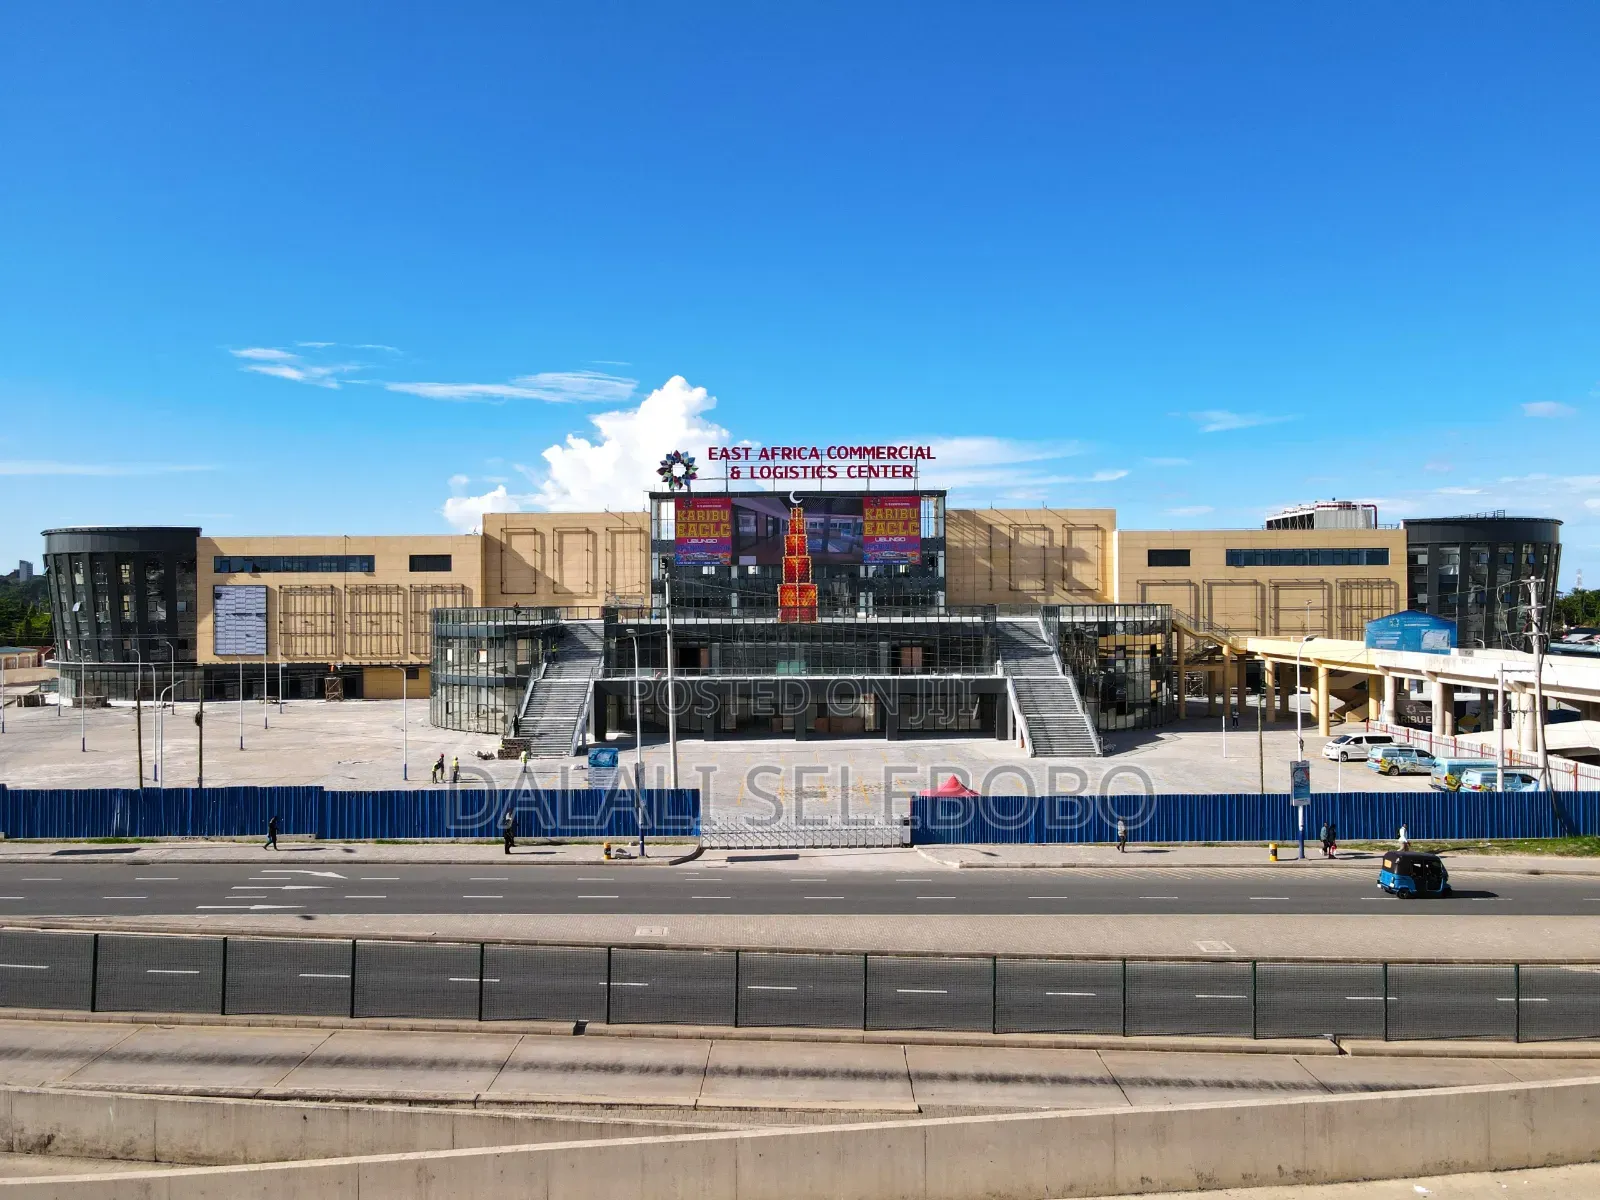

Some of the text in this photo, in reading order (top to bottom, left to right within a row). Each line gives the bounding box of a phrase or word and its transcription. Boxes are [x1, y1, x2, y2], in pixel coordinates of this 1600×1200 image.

[707, 446, 937, 460] EAST AFRICA COMMERCIAL
[729, 464, 914, 479] & LOGISTICS CENTER
[677, 510, 730, 522] KARIBU
[864, 508, 919, 520] KARIBU
[676, 523, 731, 537] EACLC
[864, 521, 920, 536] EACLC
[1395, 715, 1424, 724] ARIBU
